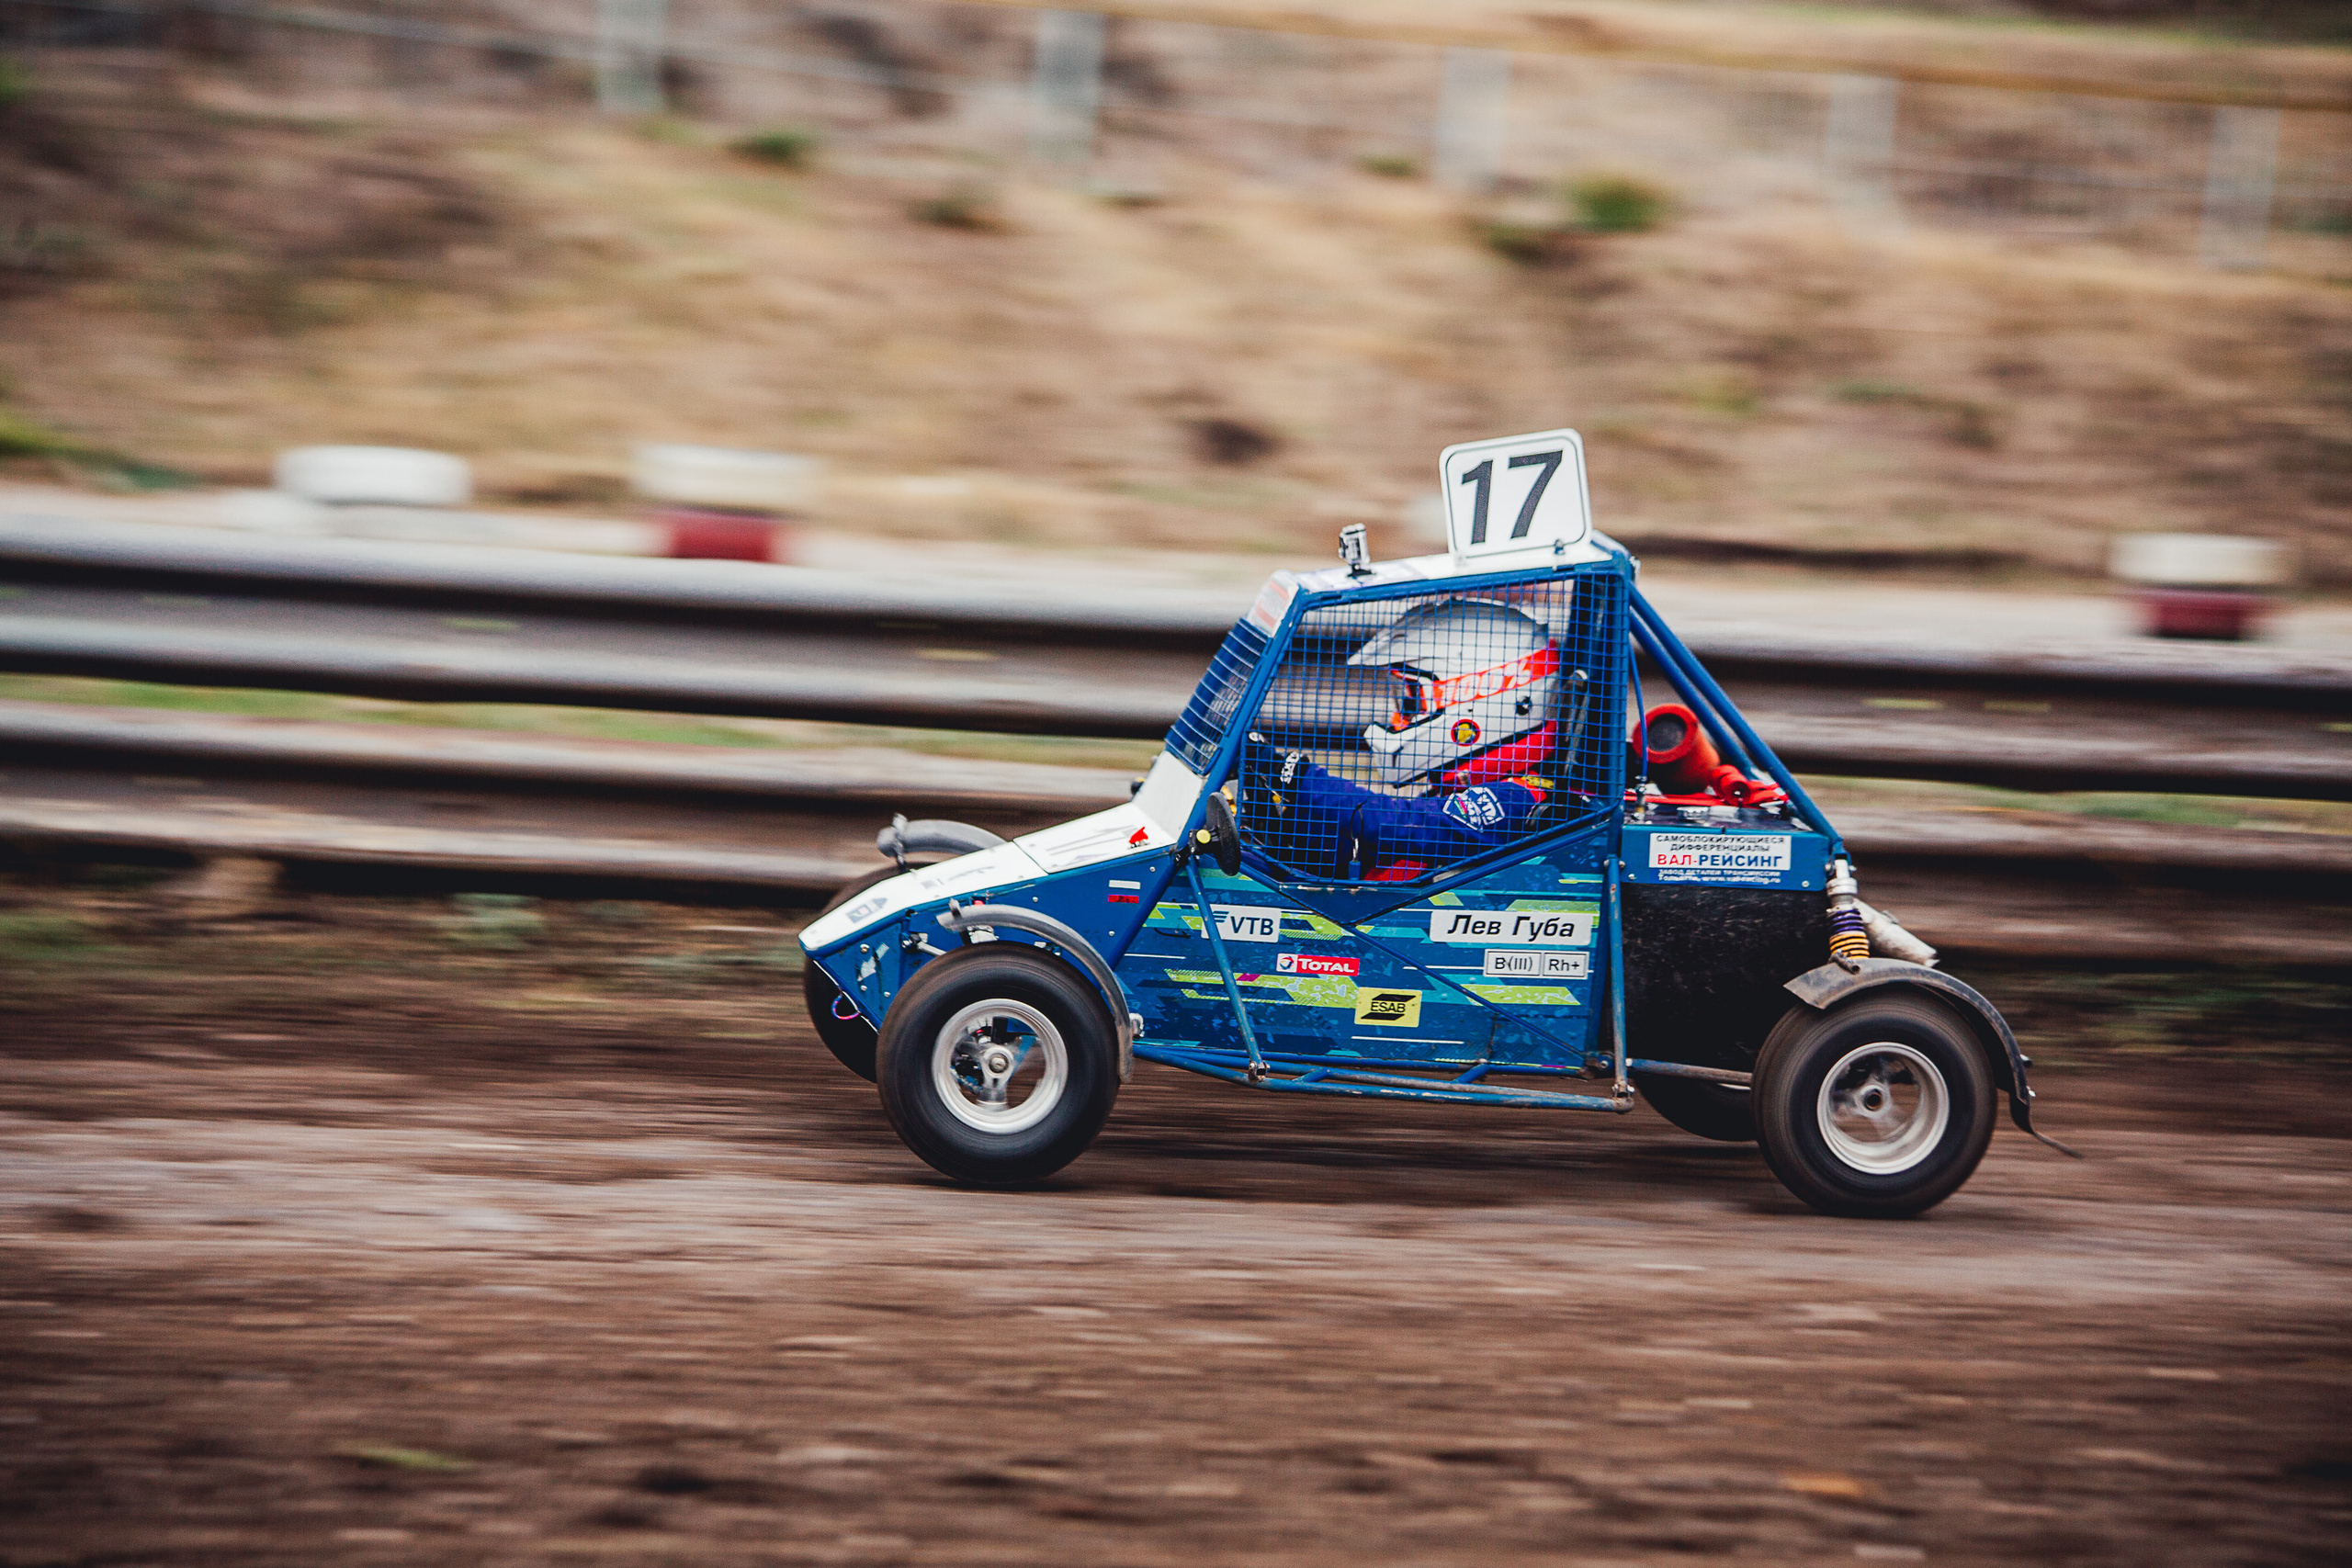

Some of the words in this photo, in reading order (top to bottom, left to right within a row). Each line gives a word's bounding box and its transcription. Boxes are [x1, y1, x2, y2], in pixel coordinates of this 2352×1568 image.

[1462, 449, 1563, 545] 17
[1657, 835, 1784, 844] САМОБЛОКИРУЮЩИЕСЯ
[1670, 843, 1770, 852] ДИФФЕРЕНЦИАЛЫ
[1657, 852, 1782, 867] ВАЛ-РЕЙСИНГ
[1230, 916, 1273, 936] VTB
[1447, 914, 1502, 935] Лев
[1512, 916, 1576, 942] Губа
[1298, 958, 1354, 974] TOTAL
[1495, 956, 1533, 972] B(III)
[1548, 959, 1579, 972] Rh+
[1370, 1001, 1406, 1013] ESAB
